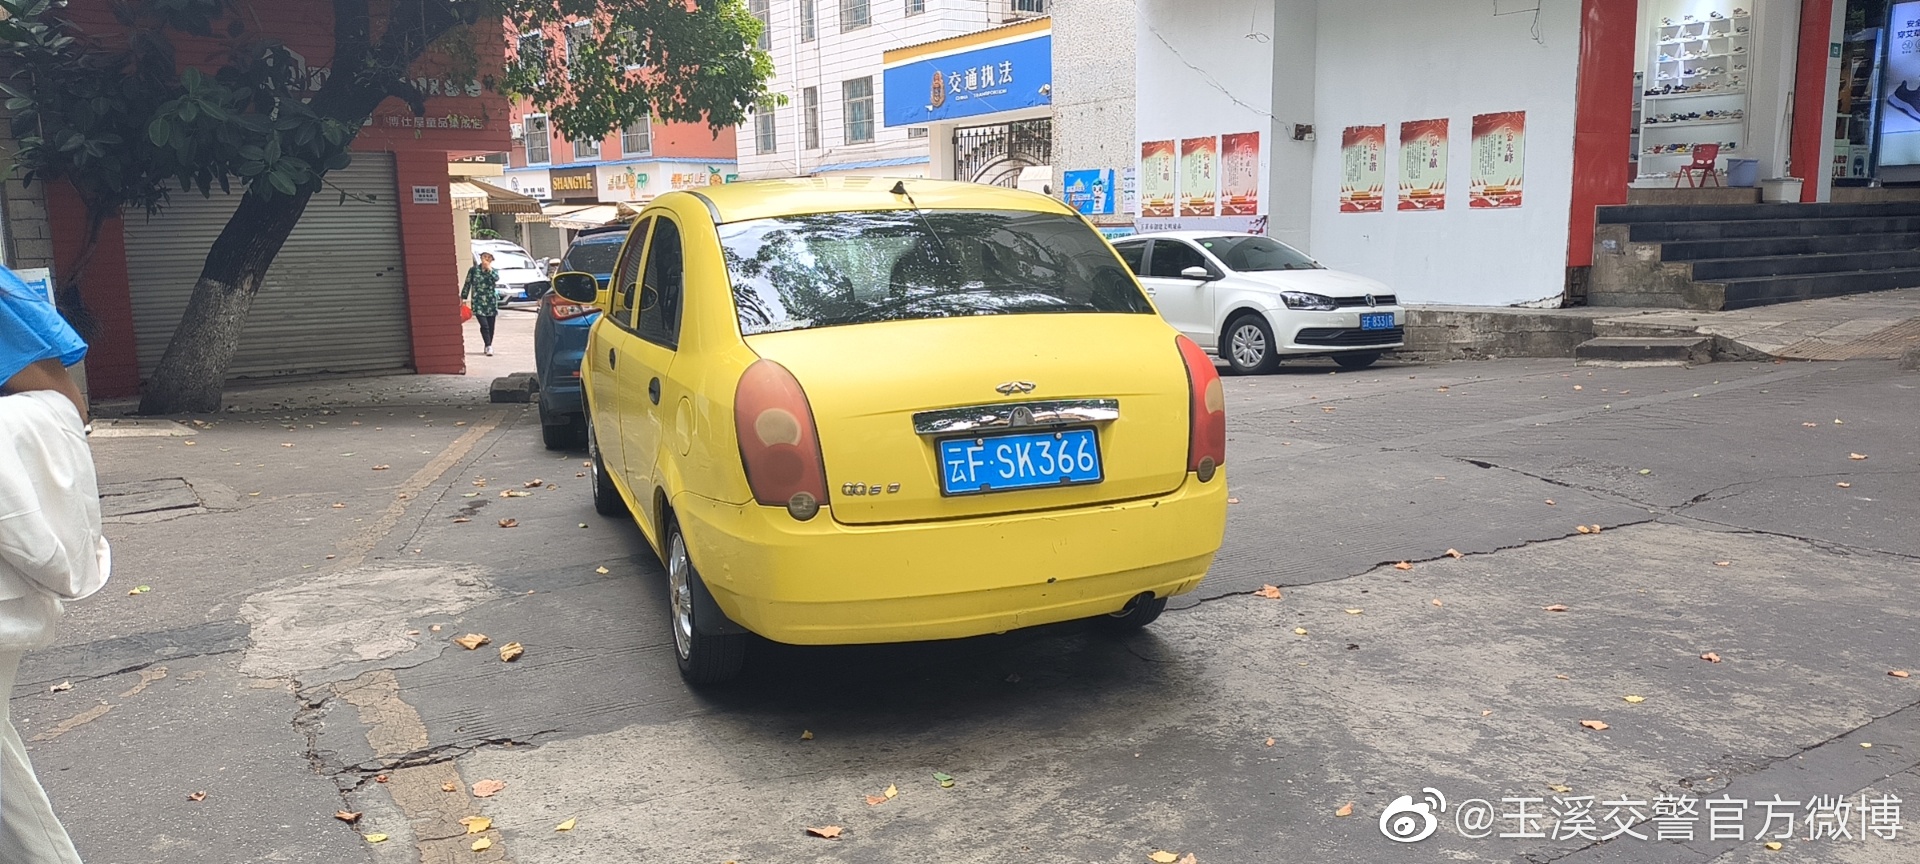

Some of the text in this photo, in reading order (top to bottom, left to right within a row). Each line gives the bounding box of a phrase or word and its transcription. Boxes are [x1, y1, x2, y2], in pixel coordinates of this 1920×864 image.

[948, 60, 1013, 94] 交通执法
[553, 175, 587, 190] SHANGYI
